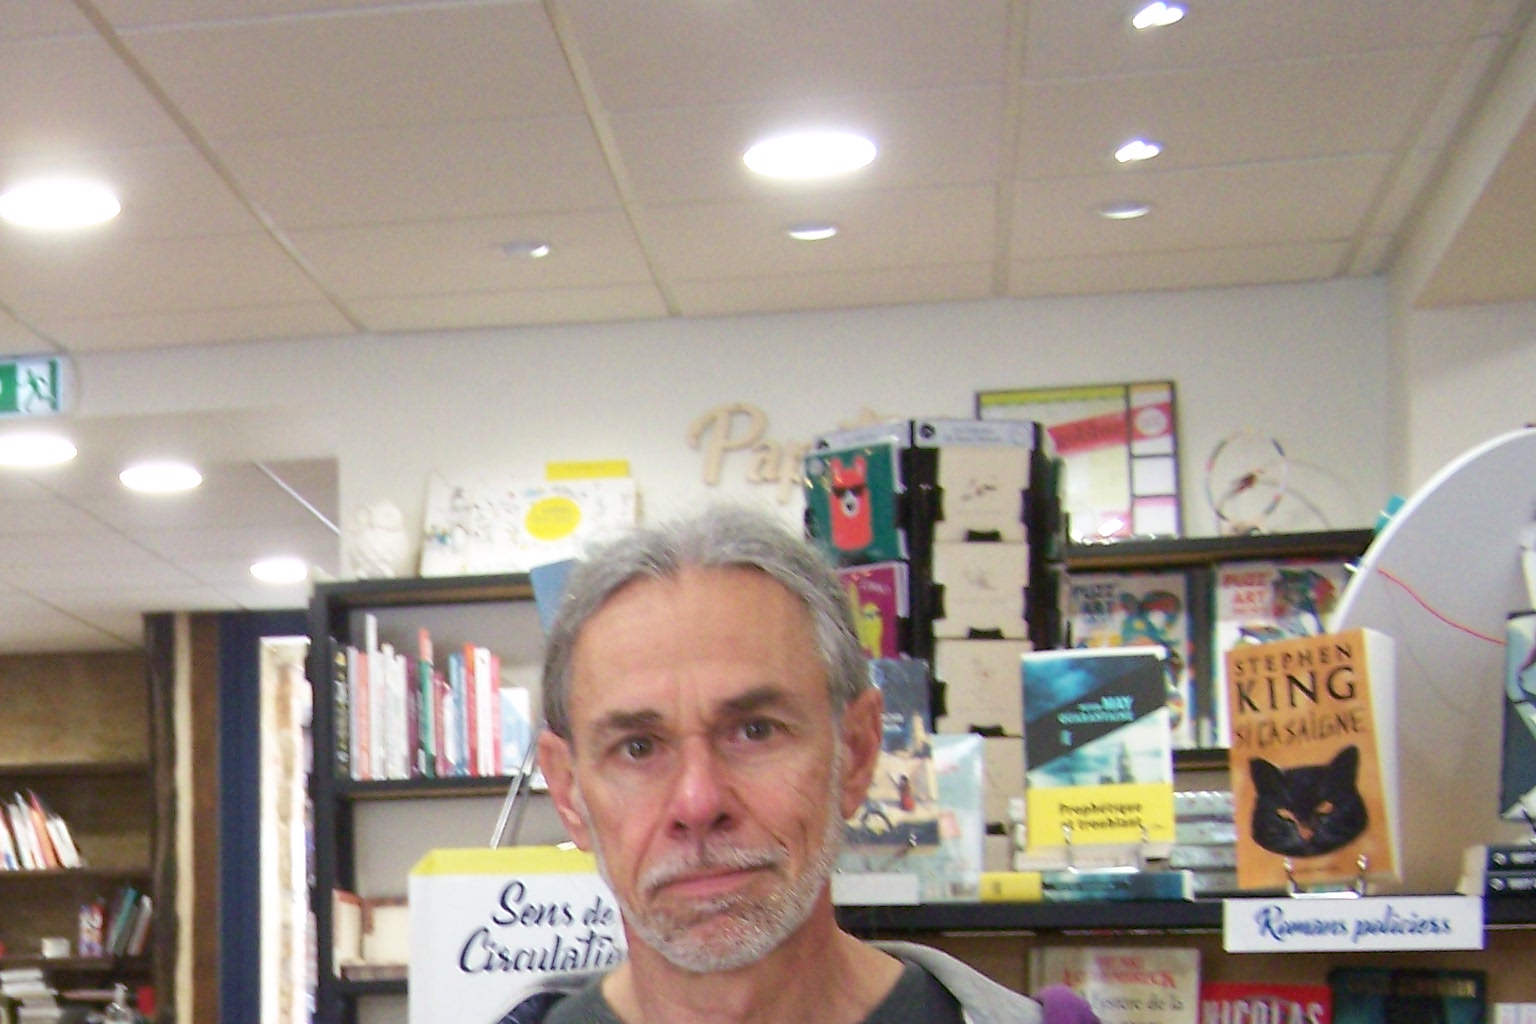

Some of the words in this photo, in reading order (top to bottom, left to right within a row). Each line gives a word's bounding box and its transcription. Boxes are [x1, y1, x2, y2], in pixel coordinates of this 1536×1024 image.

[1235, 643, 1353, 674] STEPHEN
[1237, 665, 1356, 713] KING
[492, 880, 574, 926] Sens
[581, 896, 614, 926] de
[1255, 904, 1349, 941] Romans
[1351, 904, 1452, 944] policiers
[458, 925, 622, 974] Circulatio
